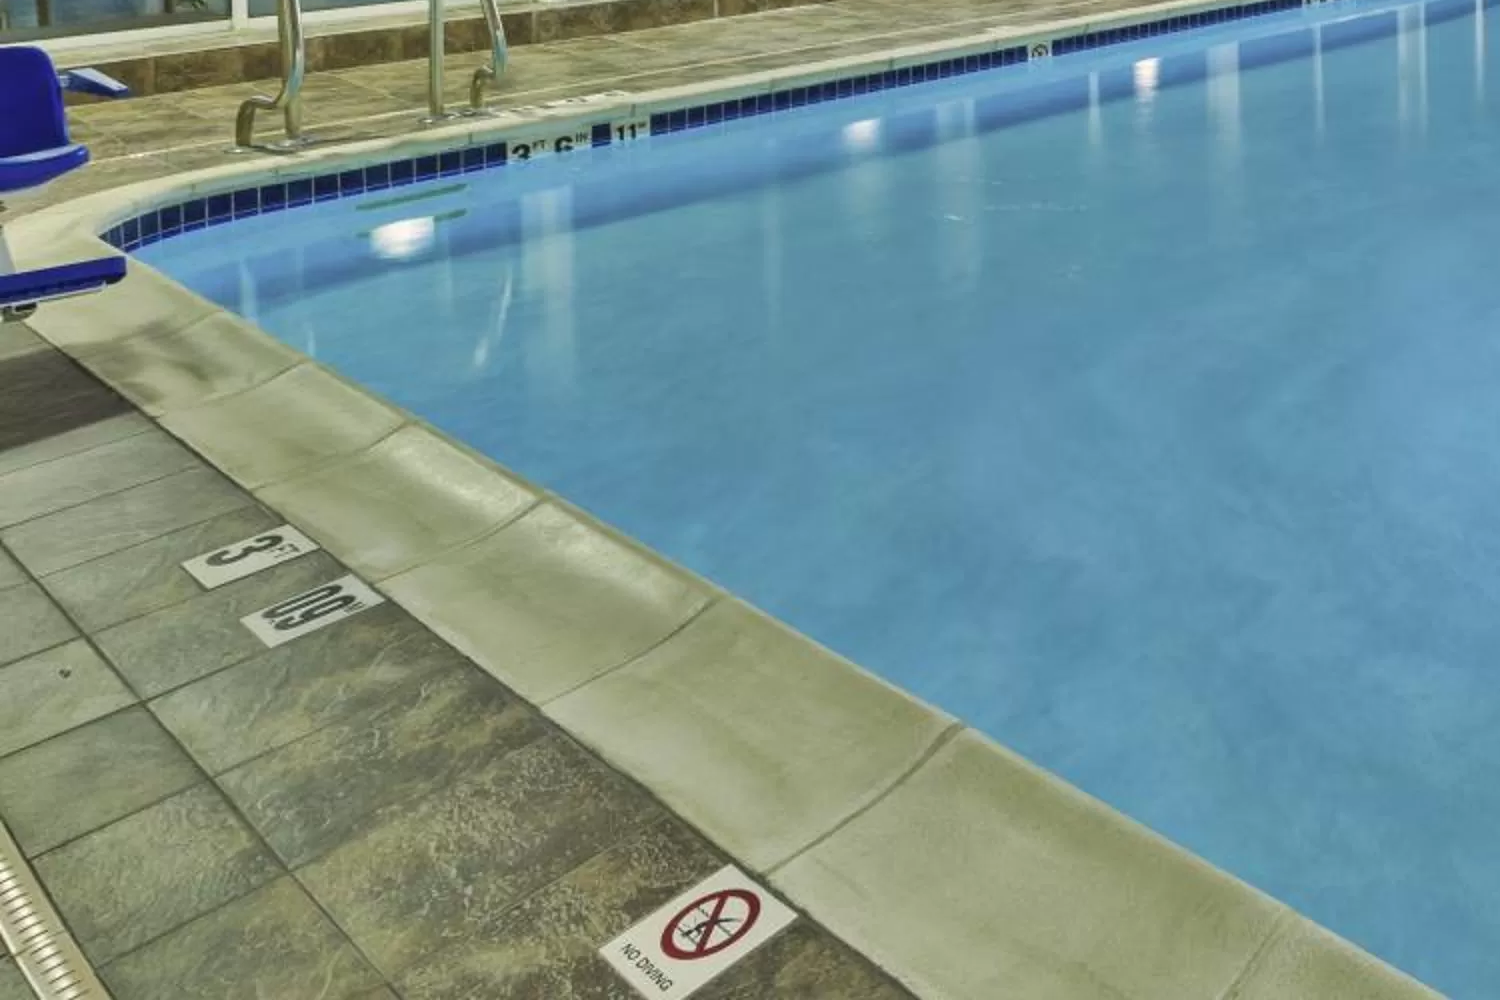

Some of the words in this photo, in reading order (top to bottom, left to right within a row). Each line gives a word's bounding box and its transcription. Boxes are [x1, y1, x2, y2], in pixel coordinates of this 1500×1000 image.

[206, 534, 284, 567] 3
[622, 943, 640, 960] NO
[636, 957, 672, 991] DIVING
